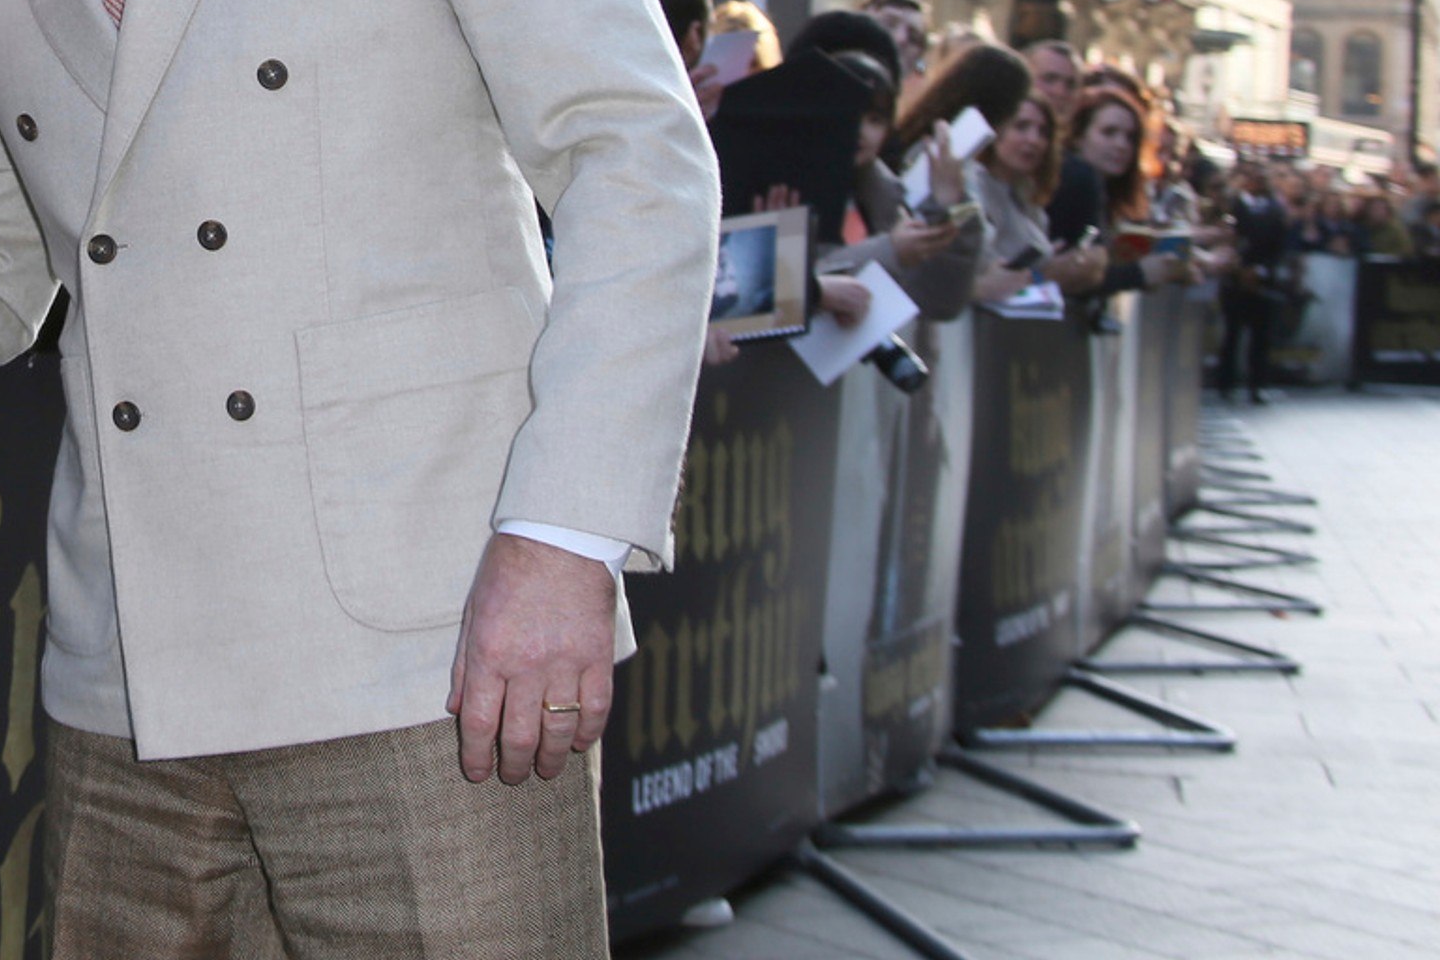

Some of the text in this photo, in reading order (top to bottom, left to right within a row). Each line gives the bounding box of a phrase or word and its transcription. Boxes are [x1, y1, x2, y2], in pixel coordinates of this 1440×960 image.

[631, 760, 693, 815] LEGEND
[695, 753, 713, 792] OF
[714, 743, 739, 784] THE
